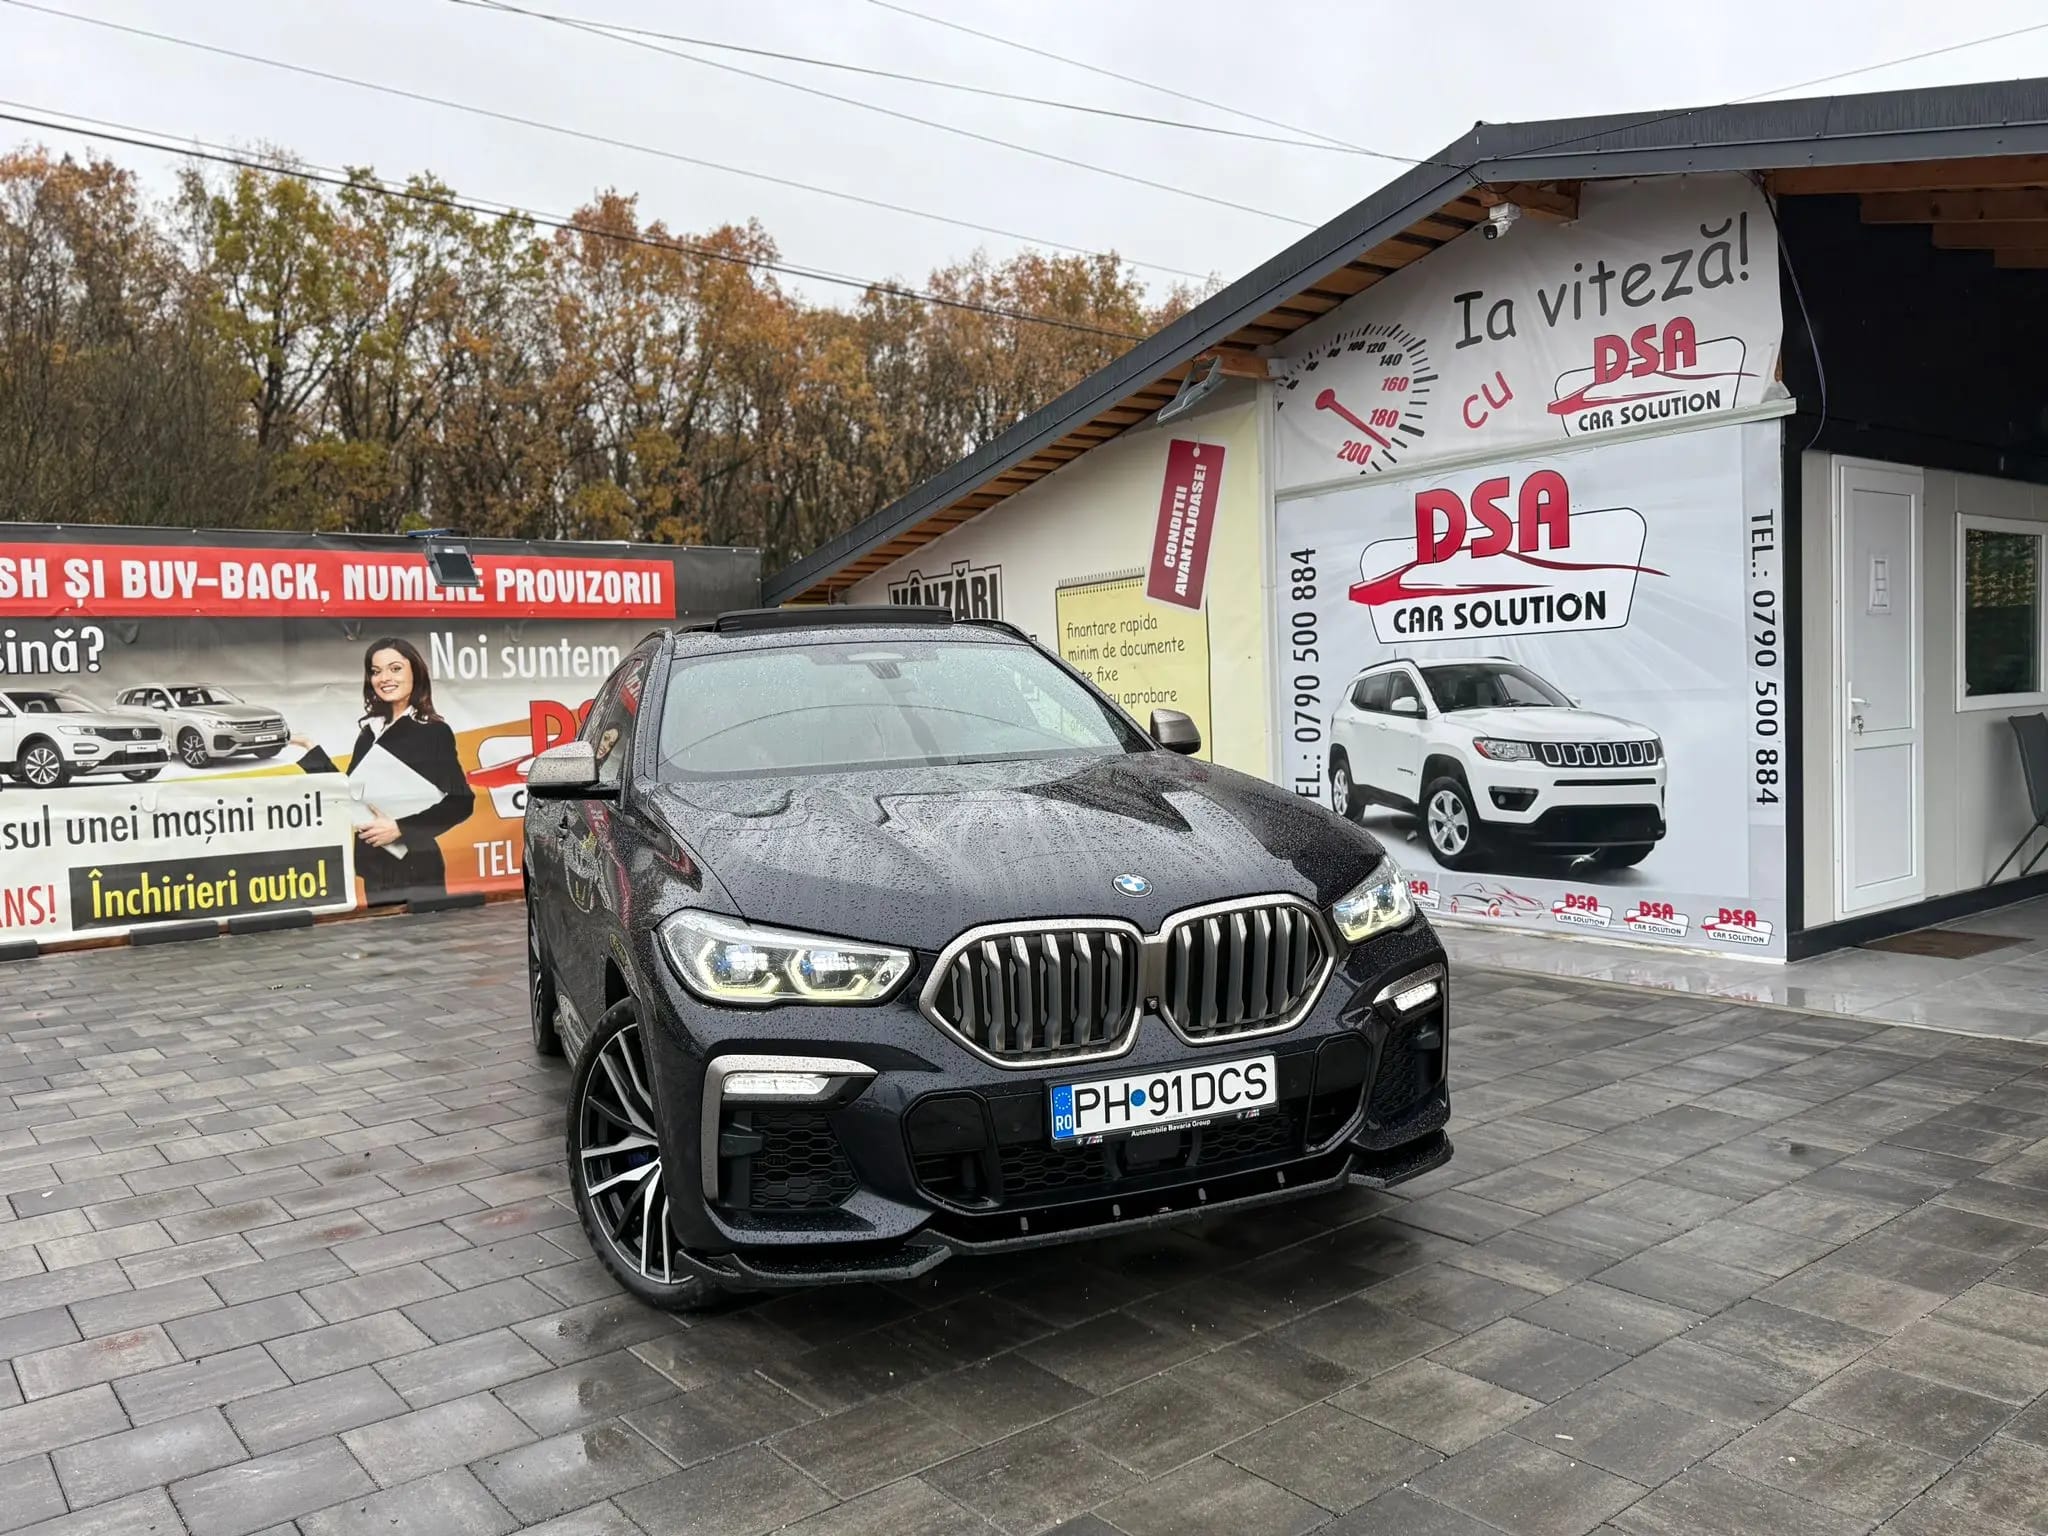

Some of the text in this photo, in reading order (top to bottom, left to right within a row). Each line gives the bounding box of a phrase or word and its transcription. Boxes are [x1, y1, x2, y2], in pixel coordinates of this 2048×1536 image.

[1454, 211, 1749, 349] Ia viteză!
[1366, 342, 1386, 354] 120
[1379, 353, 1403, 367] 140
[1594, 316, 1697, 386] DSA
[1381, 376, 1409, 392] 160
[1463, 371, 1513, 429] cu
[1369, 408, 1399, 428] 180
[1578, 389, 1721, 431] CAR SOLUTION
[1336, 440, 1372, 465] 200
[1164, 485, 1188, 568] CONDITII
[1175, 463, 1207, 597] AVANTAJOASE!
[1415, 469, 1570, 565] DSA
[63, 558, 105, 608] ȘI
[121, 560, 330, 603] BUY-BACK,
[495, 567, 662, 604] PROVIZORII
[1290, 548, 1316, 601] 884
[1067, 612, 1158, 639] finantare rapida
[1393, 590, 1606, 634] CAR SOLUTION
[0, 625, 105, 675] ină?
[430, 631, 620, 681] Noi suntem
[1068, 636, 1185, 662] minim de documente
[1292, 611, 1319, 662] 500
[1097, 665, 1119, 683] fixe
[1751, 509, 1779, 805] TEL.: 0790 500 884
[1123, 686, 1178, 708] aprobare
[1293, 674, 1321, 743] 0790
[0, 791, 323, 851] sul unei mașini noi!
[473, 839, 521, 878] TEL
[0, 859, 328, 928] NS! Închirieri auto!
[1408, 880, 1429, 895] SA
[1565, 893, 1598, 912] DSA
[1639, 900, 1674, 921] DSA
[1650, 925, 1682, 936] SOLUTION
[1718, 908, 1757, 929] DSA
[1728, 933, 1765, 944] SOLUTION
[1056, 1114, 1072, 1131] RO
[1075, 1083, 1131, 1128] PH
[1131, 1118, 1211, 1138] Automobile Bavaria Group
